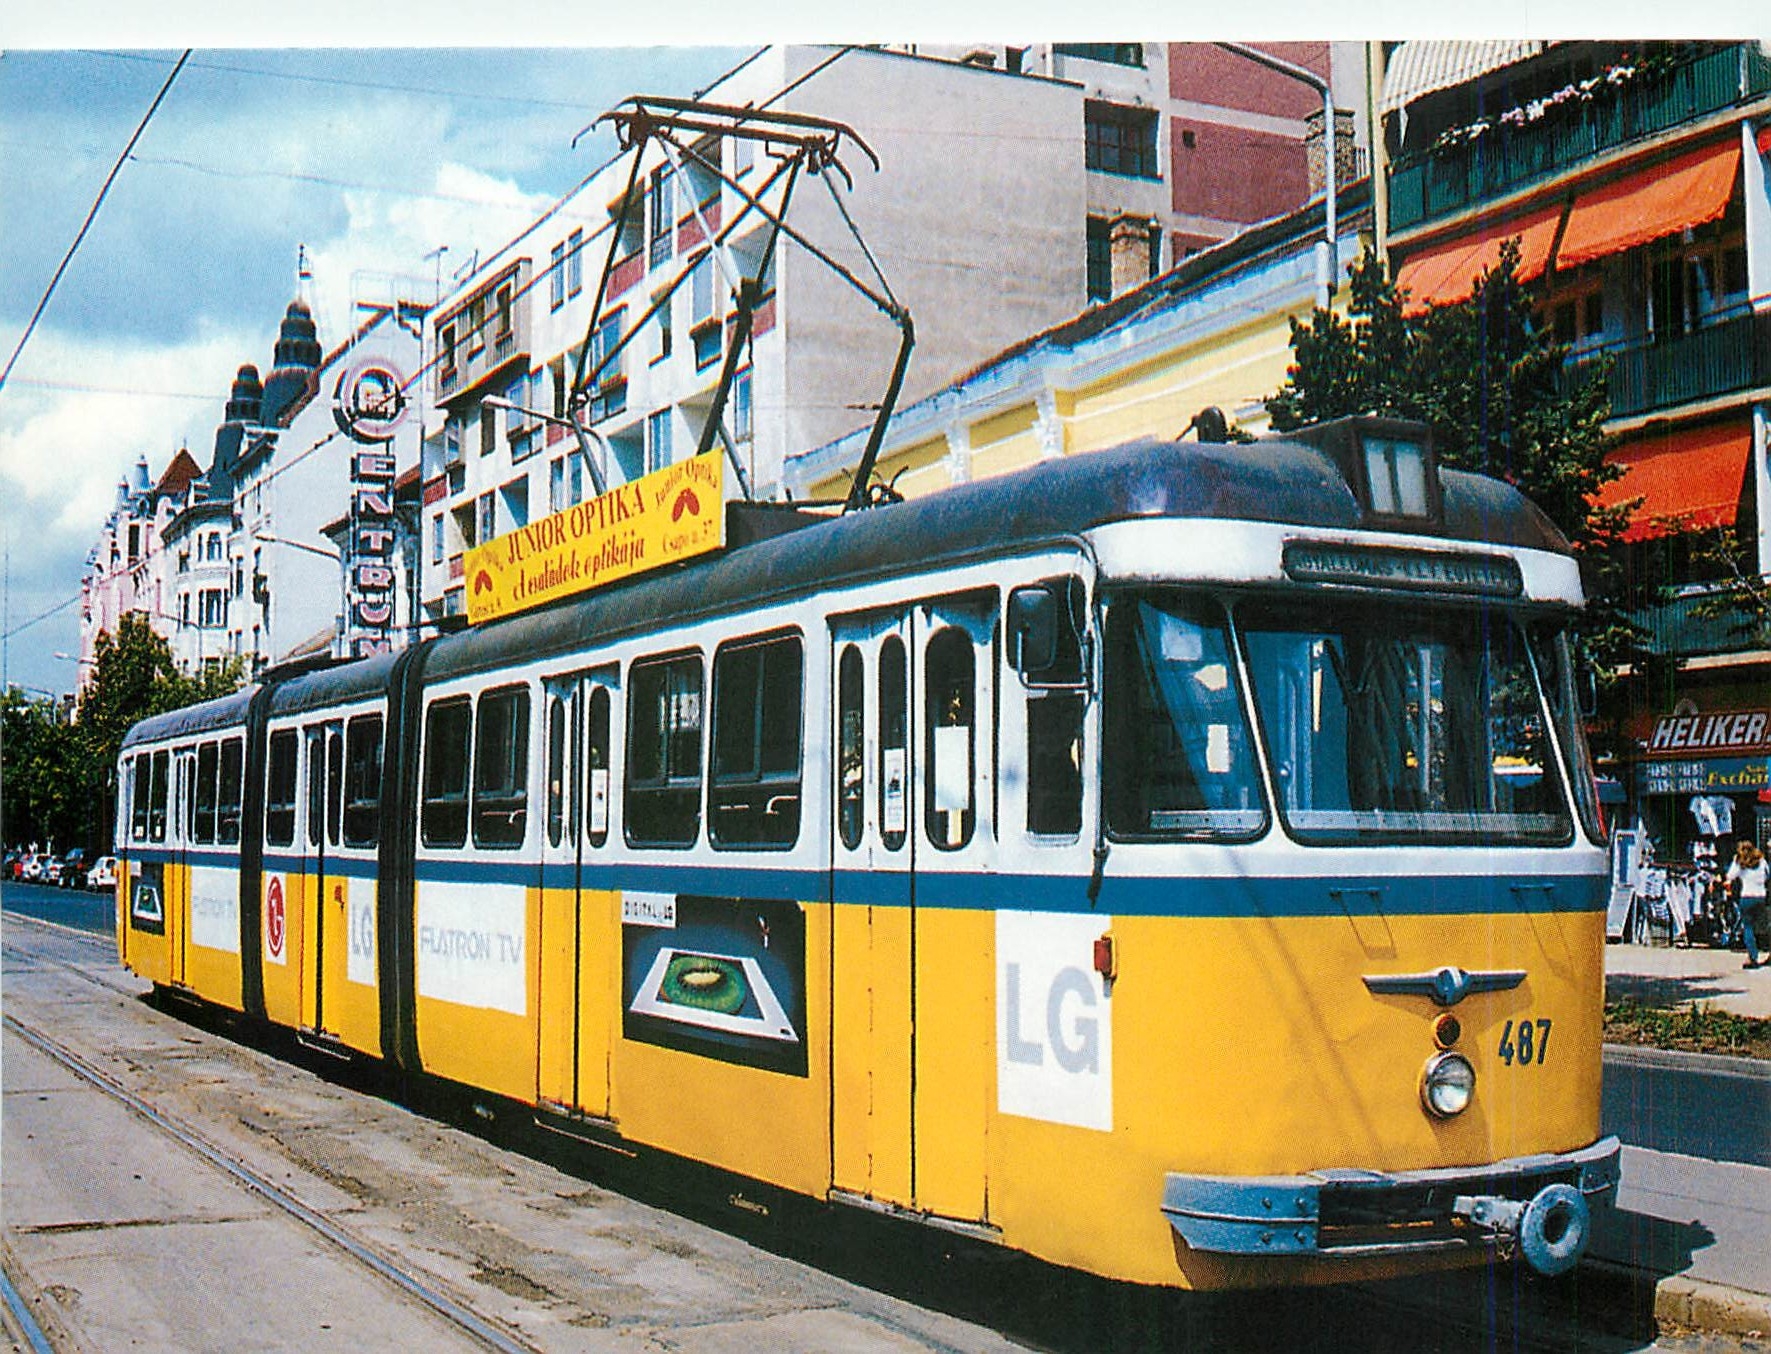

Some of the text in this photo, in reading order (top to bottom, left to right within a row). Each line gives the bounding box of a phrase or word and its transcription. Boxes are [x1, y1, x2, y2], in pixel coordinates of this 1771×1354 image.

[509, 513, 566, 564] JUNIOR
[570, 482, 645, 539] OPTIKA
[352, 902, 374, 960] LG
[420, 925, 523, 964] FLATRON TV
[1006, 961, 1100, 1075] LG
[1498, 1018, 1552, 1067] 487
